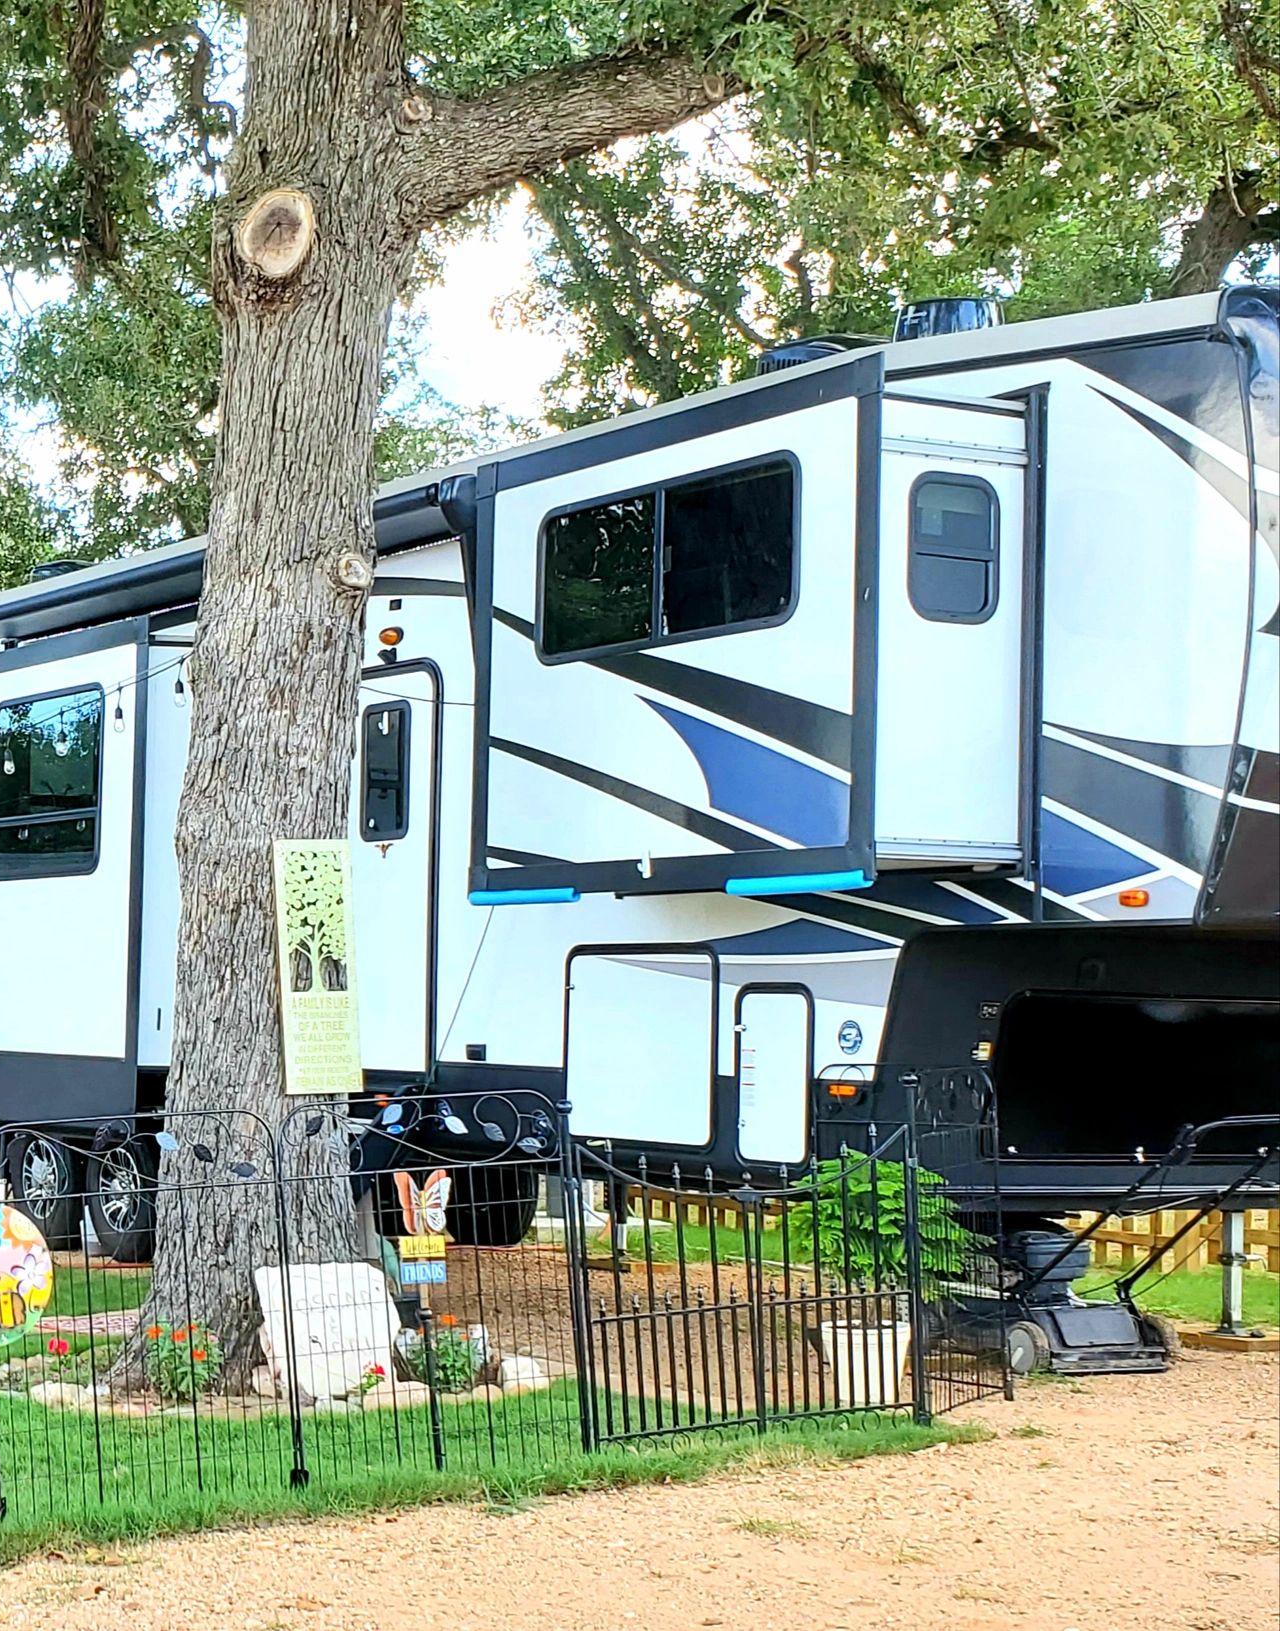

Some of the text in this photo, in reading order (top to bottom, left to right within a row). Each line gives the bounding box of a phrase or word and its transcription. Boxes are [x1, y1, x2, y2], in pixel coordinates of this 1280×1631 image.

[298, 996, 324, 1009] FAMILY
[298, 1020, 345, 1031] OF A TREE
[293, 1032, 351, 1042] WE ALL GROW
[294, 1054, 353, 1064] DIRECTIONS
